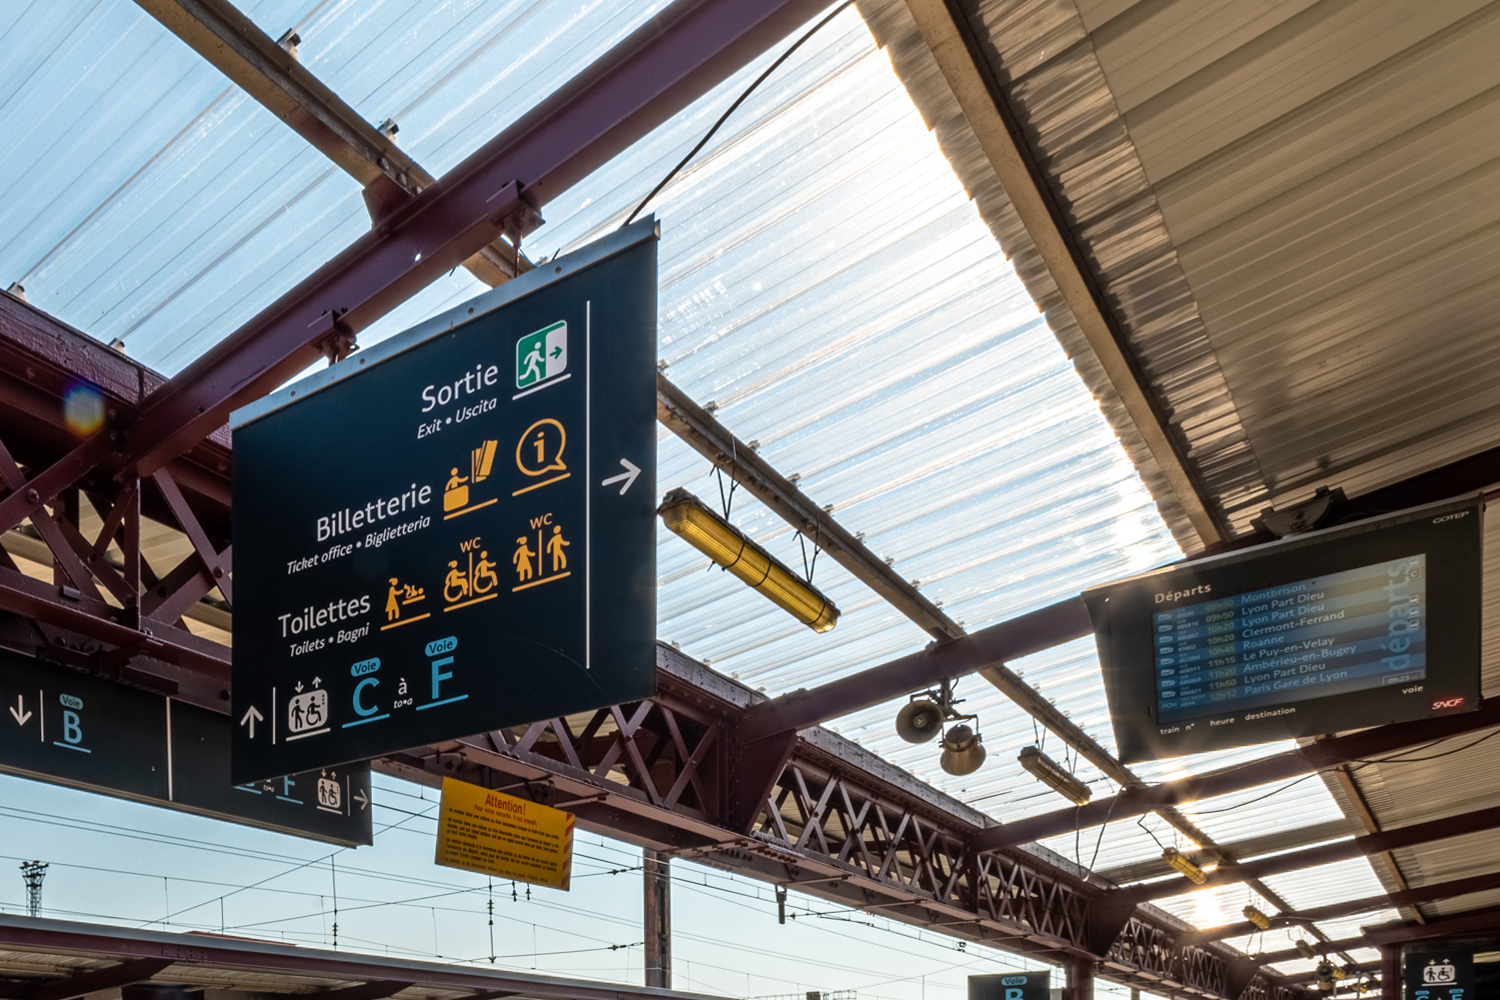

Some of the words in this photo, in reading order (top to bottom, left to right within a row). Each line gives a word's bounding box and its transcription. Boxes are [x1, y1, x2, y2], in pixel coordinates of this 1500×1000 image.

[422, 364, 498, 412] Sortie
[417, 418, 442, 439] Exit
[456, 398, 497, 423] Uscita
[317, 483, 432, 542] Billetterie
[530, 512, 552, 530] WC
[1432, 511, 1469, 524] COTEP
[287, 554, 319, 574] Ticket
[321, 544, 352, 563] office
[365, 516, 430, 548] Biglietteria
[460, 536, 481, 552] WC
[1154, 584, 1212, 604] Départs
[1205, 600, 1234, 611] 09h50
[1242, 584, 1305, 603] Montbrison
[1206, 610, 1234, 623] 09h50
[1242, 604, 1268, 615] Lyon
[1272, 598, 1294, 608] Part
[1298, 592, 1324, 603] Dieu
[278, 594, 370, 638] Toilettes
[1207, 622, 1234, 634] 10h20
[1242, 615, 1268, 627] Lyon
[1272, 609, 1294, 620] Part
[1298, 604, 1324, 615] Dieu
[1207, 634, 1235, 645] 10h20
[1242, 610, 1344, 638] Clermont-Ferrand
[290, 638, 325, 658] Toilets
[337, 622, 370, 644] Bagni
[429, 640, 453, 654] Voie
[1208, 645, 1235, 656] 10h45
[1243, 635, 1284, 649] Roanne
[1208, 656, 1236, 668] 11h15
[1244, 652, 1256, 660] Le
[1259, 638, 1334, 658] Puy-en-Velay
[354, 661, 376, 674] Voie
[1209, 668, 1236, 678] 11h20
[1244, 645, 1356, 672] Ambérieu-en-Bugey
[352, 677, 380, 716] C
[398, 678, 407, 695] à
[432, 656, 454, 699] F
[1209, 678, 1236, 690] 11h50
[1244, 672, 1270, 684] Lyon
[1274, 667, 1296, 678] Part
[1300, 663, 1325, 673] Dieu
[1210, 690, 1237, 701] 12h12
[1245, 684, 1270, 694] Paris
[1274, 680, 1299, 689] Gare
[1302, 676, 1316, 684] de
[1320, 671, 1347, 681] Lyon
[1402, 684, 1424, 694] voie
[62, 695, 80, 708] Voie
[1432, 698, 1464, 710] SNCF
[64, 710, 82, 744] B
[1160, 726, 1180, 735] train
[1210, 718, 1235, 726] heure
[1245, 707, 1296, 720] destination
[486, 793, 526, 816] Attention!
